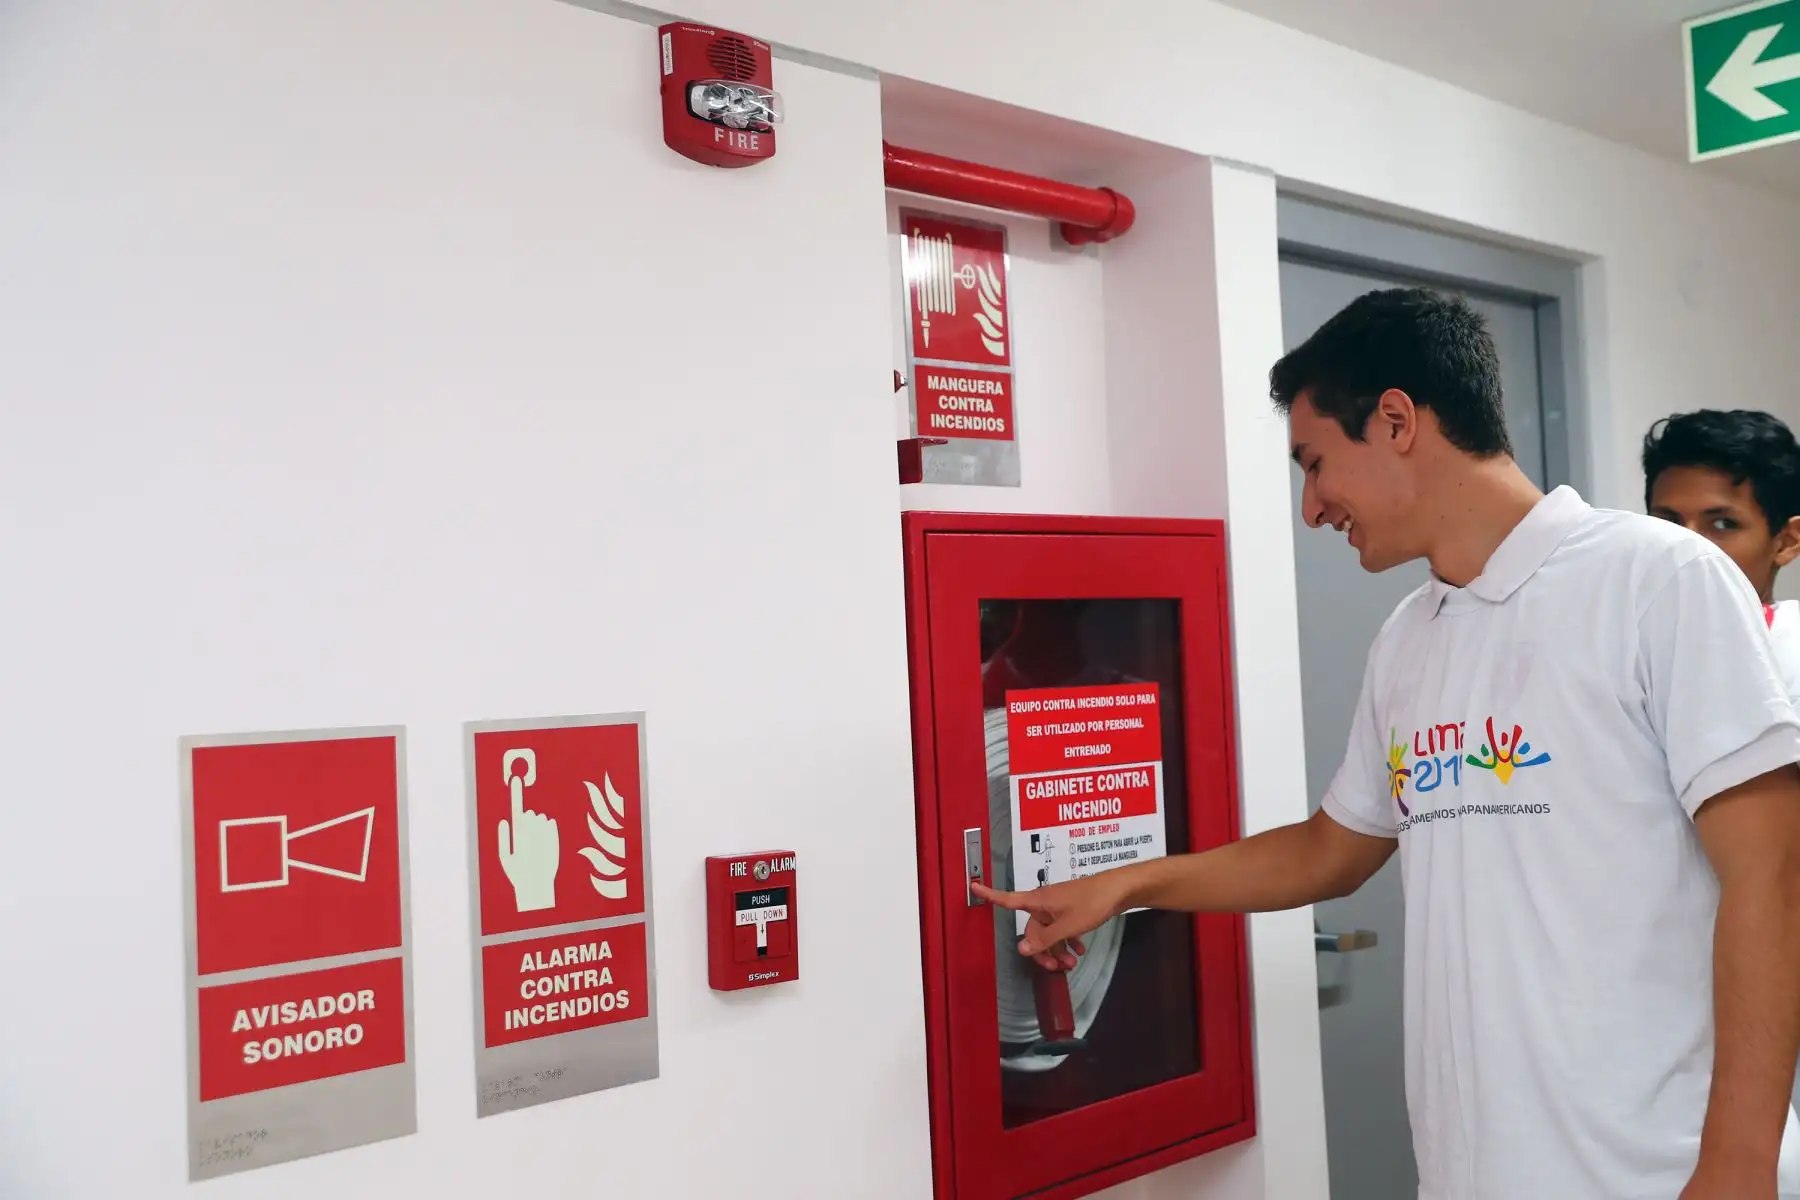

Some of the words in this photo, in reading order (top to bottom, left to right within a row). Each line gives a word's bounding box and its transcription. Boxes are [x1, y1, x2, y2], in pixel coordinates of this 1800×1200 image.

[714, 127, 759, 150] FIRE
[927, 375, 1004, 395] MANGUERA
[938, 395, 994, 413] CONTRA
[930, 413, 1005, 432] INCENDIOS
[1010, 700, 1041, 713] EQUIPO
[1043, 699, 1076, 712] CONTRA
[1077, 696, 1114, 709] INCENDIO
[1116, 695, 1135, 706] SOLO
[1137, 694, 1156, 704] PARA
[1026, 726, 1042, 737] SER
[1044, 722, 1086, 736] UTILIZADO
[1088, 721, 1103, 732] POR
[1105, 718, 1144, 731] PERSONAL
[1064, 744, 1112, 758] ENTRENADO
[1026, 776, 1094, 800] GABINETE
[1097, 770, 1150, 792] CONTRA
[1058, 797, 1122, 821] INCENDIO
[1069, 828, 1086, 838] MODO
[1089, 827, 1095, 836] DE
[1098, 823, 1120, 834] EMPLEO
[730, 861, 747, 877] FIRE
[770, 857, 796, 872] ALARM
[752, 894, 770, 905] PUSH
[740, 912, 758, 922] PULL
[764, 908, 783, 920] DOWN
[520, 940, 613, 973] ALARMA
[520, 967, 614, 1000] CONTRA
[754, 971, 779, 980] Simplex
[231, 989, 376, 1033] AVISADOR
[505, 990, 630, 1030] INCENDIOS
[242, 1024, 364, 1064] SONORO
